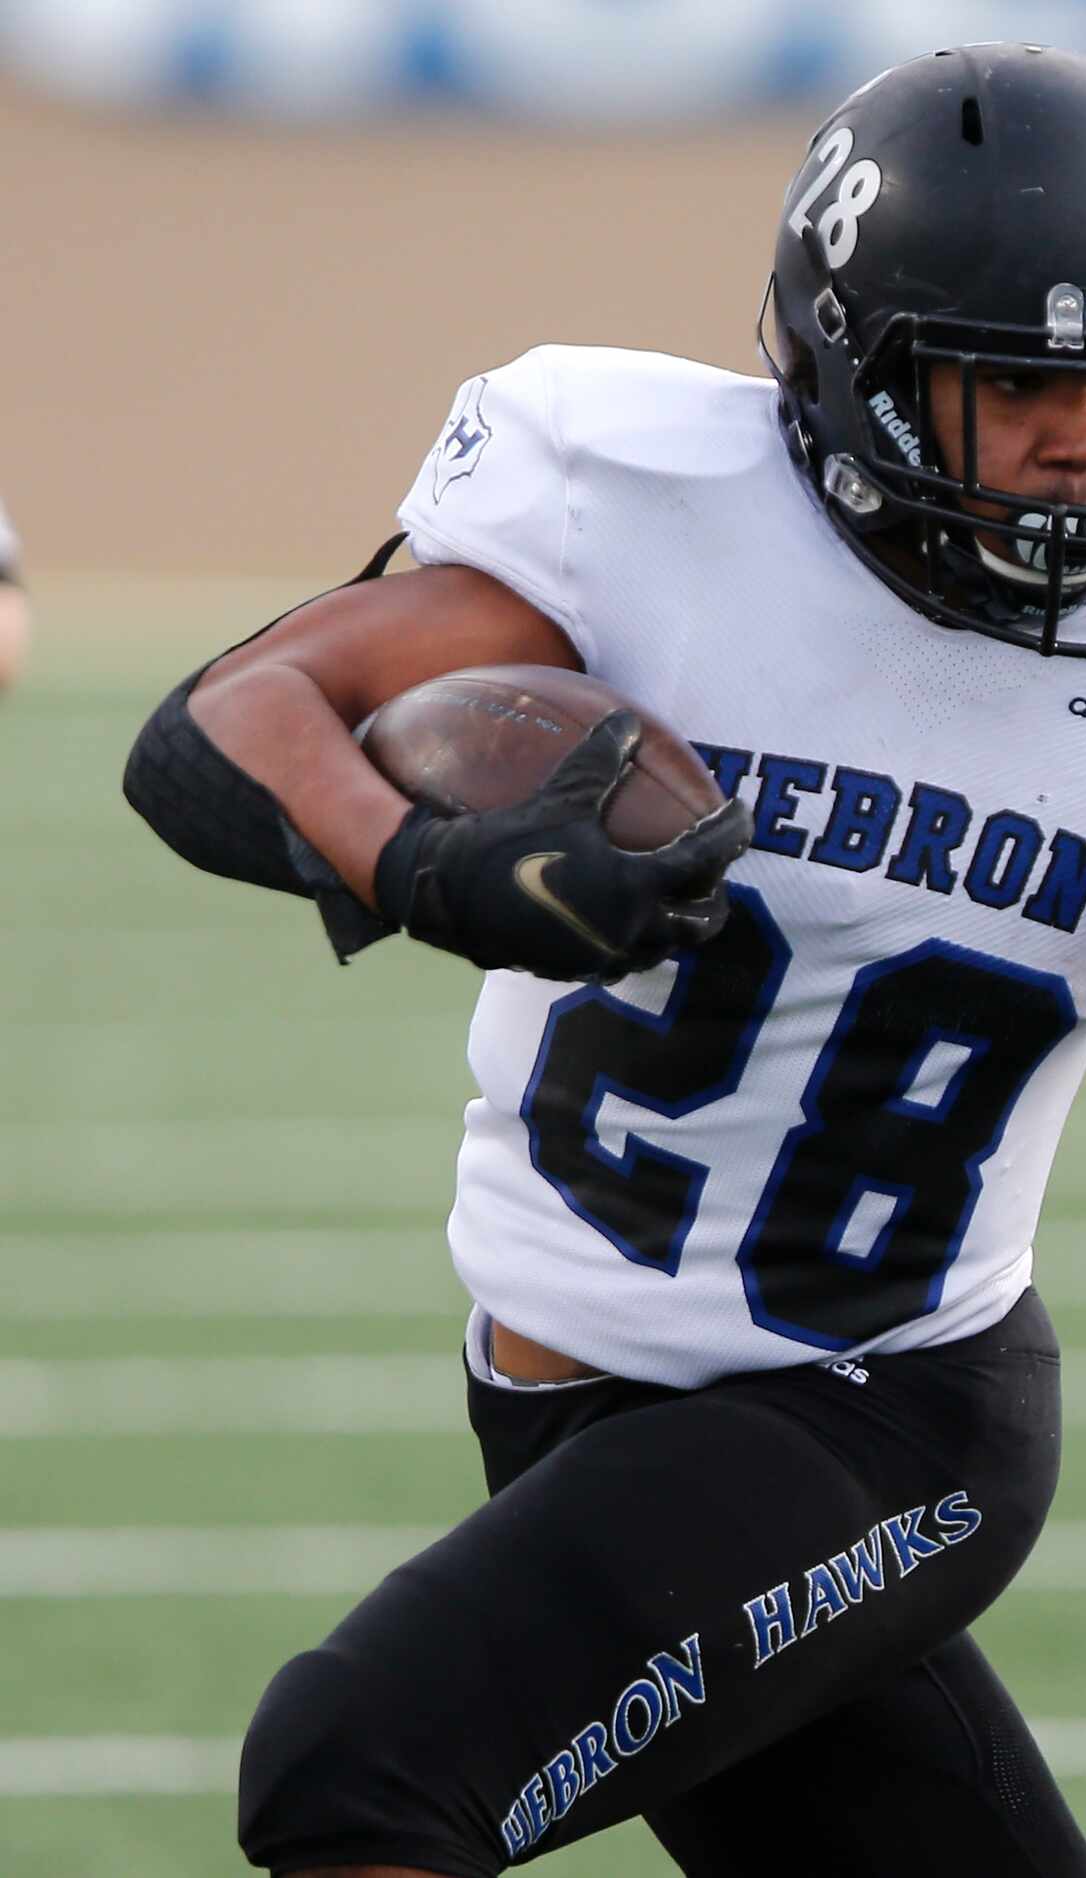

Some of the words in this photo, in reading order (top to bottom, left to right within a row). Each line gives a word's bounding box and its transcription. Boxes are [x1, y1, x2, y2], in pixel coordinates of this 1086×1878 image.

[788, 127, 882, 269] 28
[868, 390, 921, 467] Ridde
[521, 879, 1077, 1351] 28
[501, 1632, 706, 1858] HEBRON
[743, 1491, 983, 1669] HAWKS
